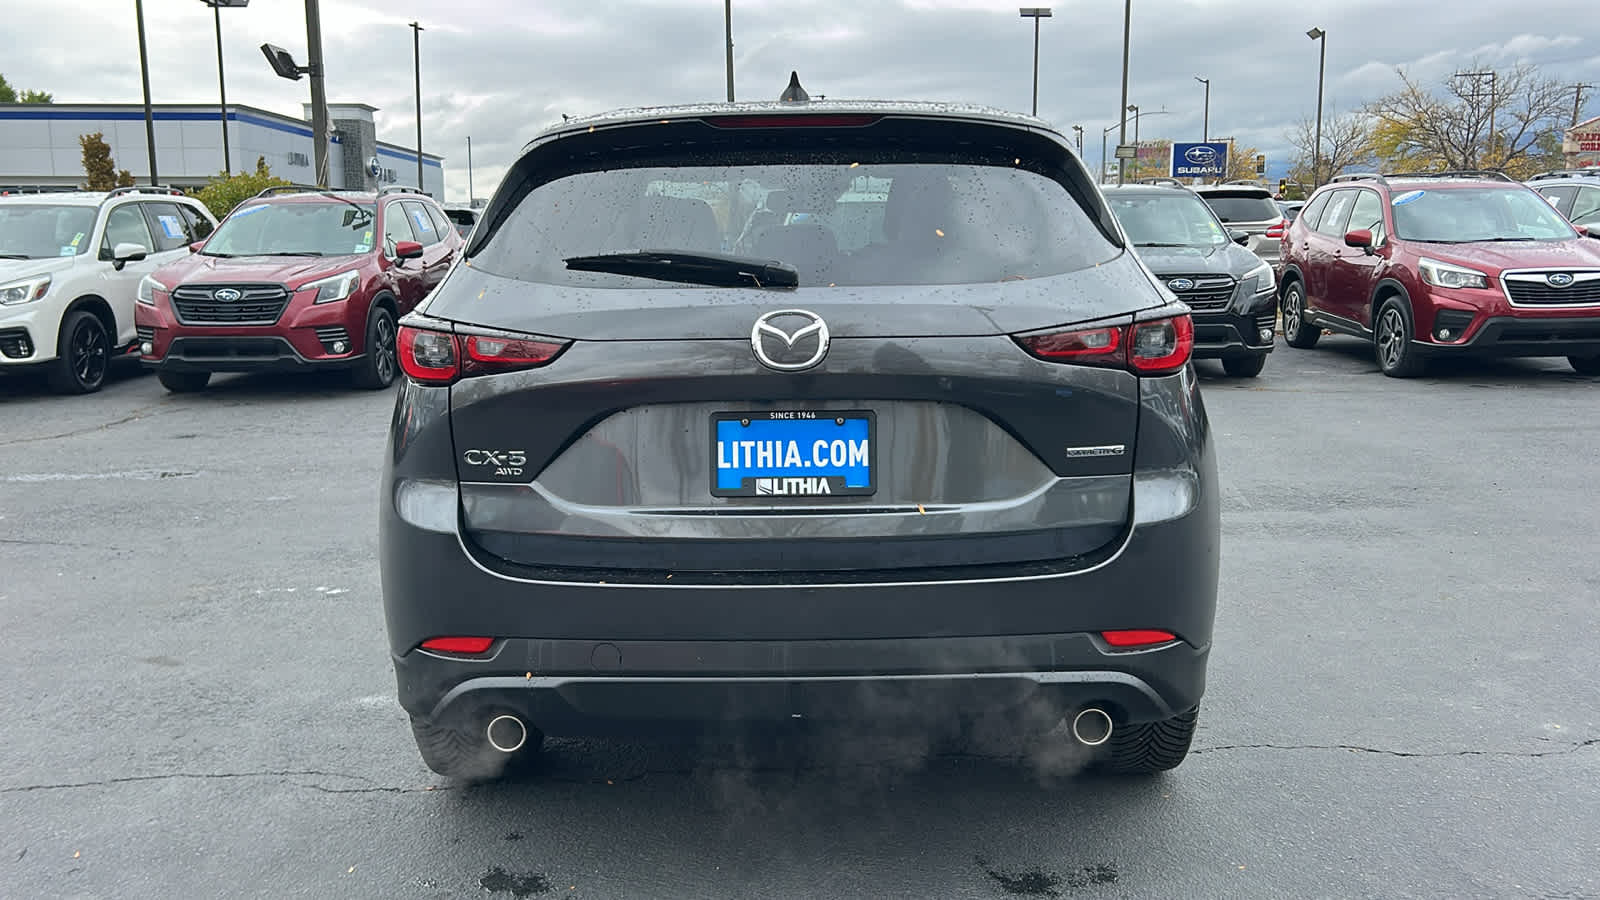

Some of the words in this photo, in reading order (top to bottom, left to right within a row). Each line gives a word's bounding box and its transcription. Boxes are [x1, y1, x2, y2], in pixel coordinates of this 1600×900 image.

[1177, 166, 1223, 174] SUBARU
[770, 412, 795, 420] SINCE
[797, 411, 816, 419] 1946
[464, 449, 527, 466] CX-5
[717, 439, 869, 469] LITHIA.COM
[495, 467, 523, 476] AWD
[773, 477, 831, 495] LITHIA
